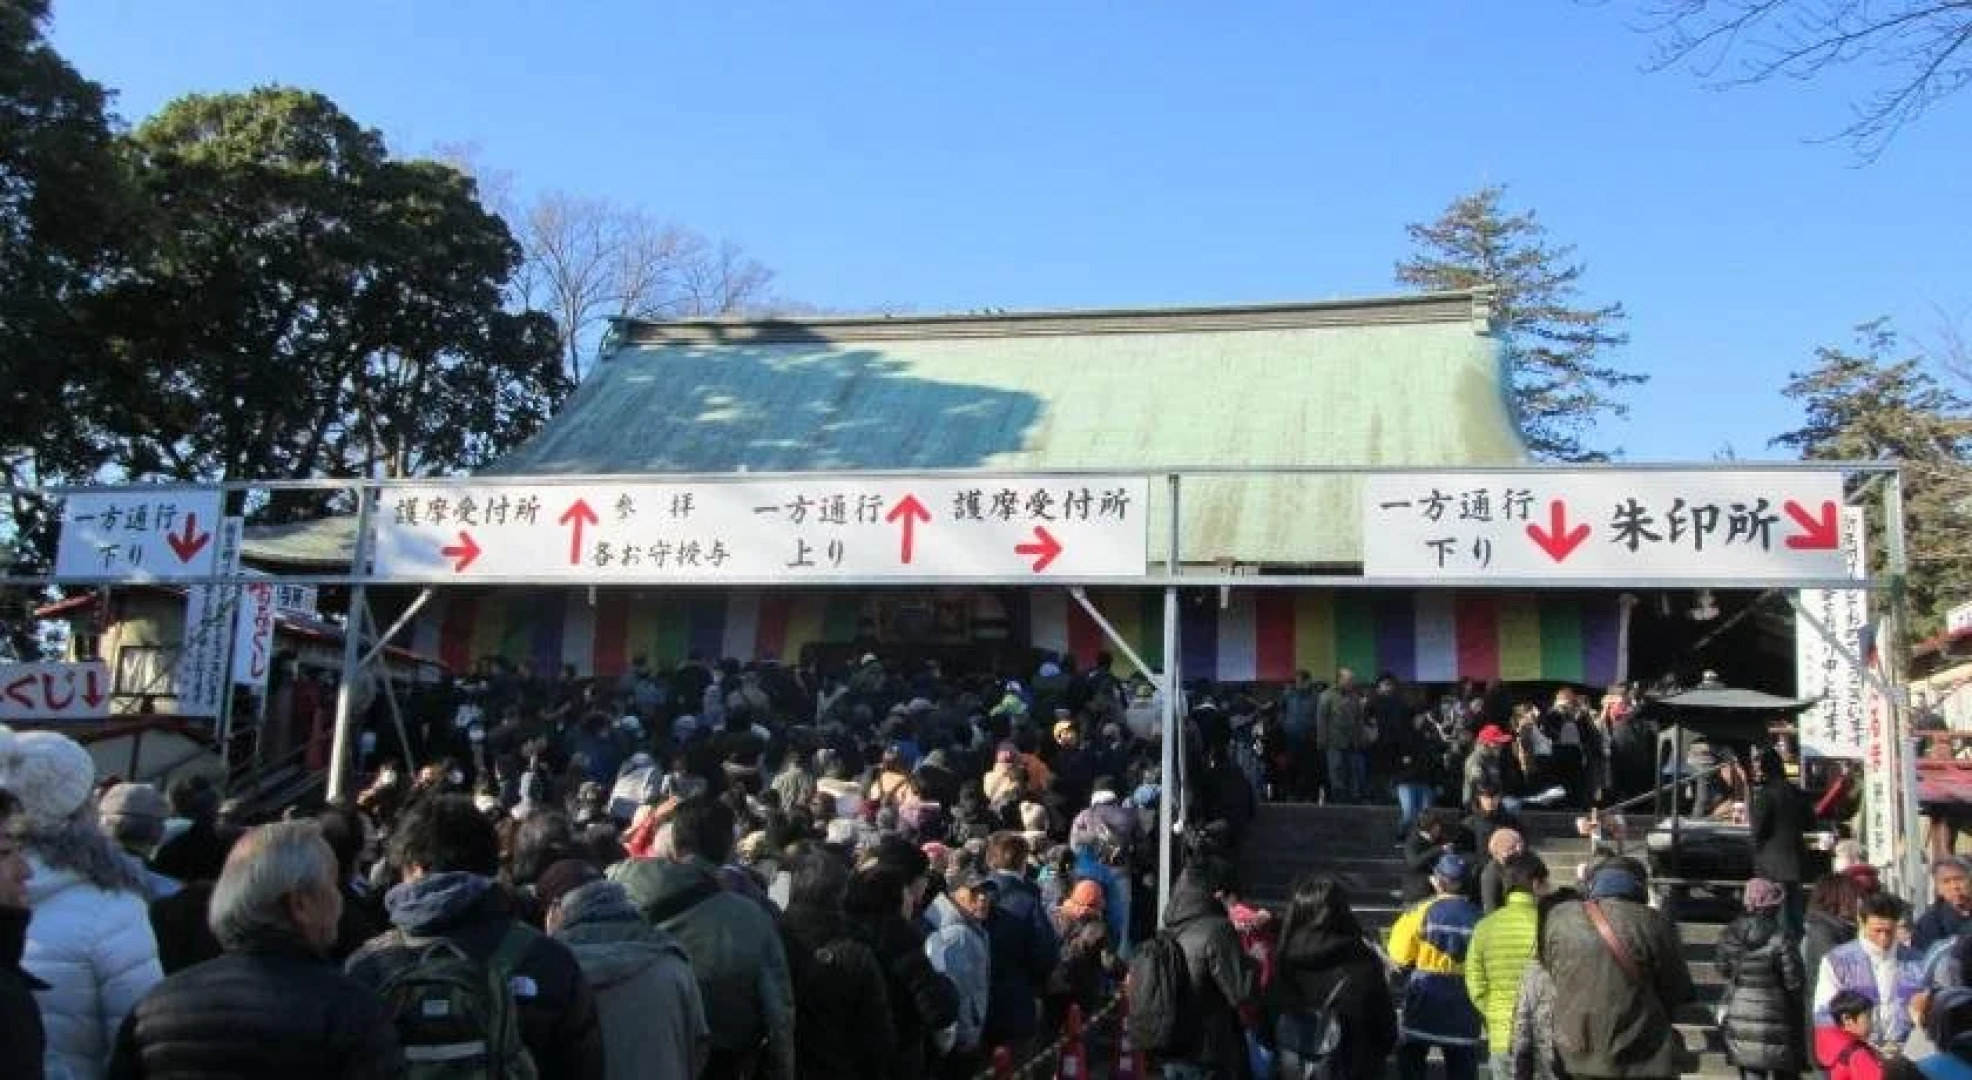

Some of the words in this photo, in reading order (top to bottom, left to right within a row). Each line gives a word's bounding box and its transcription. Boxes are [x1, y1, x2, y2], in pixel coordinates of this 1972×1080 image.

[75, 504, 177, 532] 一方通行
[394, 494, 541, 526] 護摩受付所
[753, 494, 884, 524] 一方通行
[953, 488, 1131, 521] 護摩受付所
[1380, 488, 1535, 522] 一方通行
[1610, 498, 1780, 552] 朱印所
[101, 545, 142, 568] 下り
[787, 539, 844, 568] 上り
[1425, 536, 1492, 569] 下り
[0, 669, 76, 710] くじ
